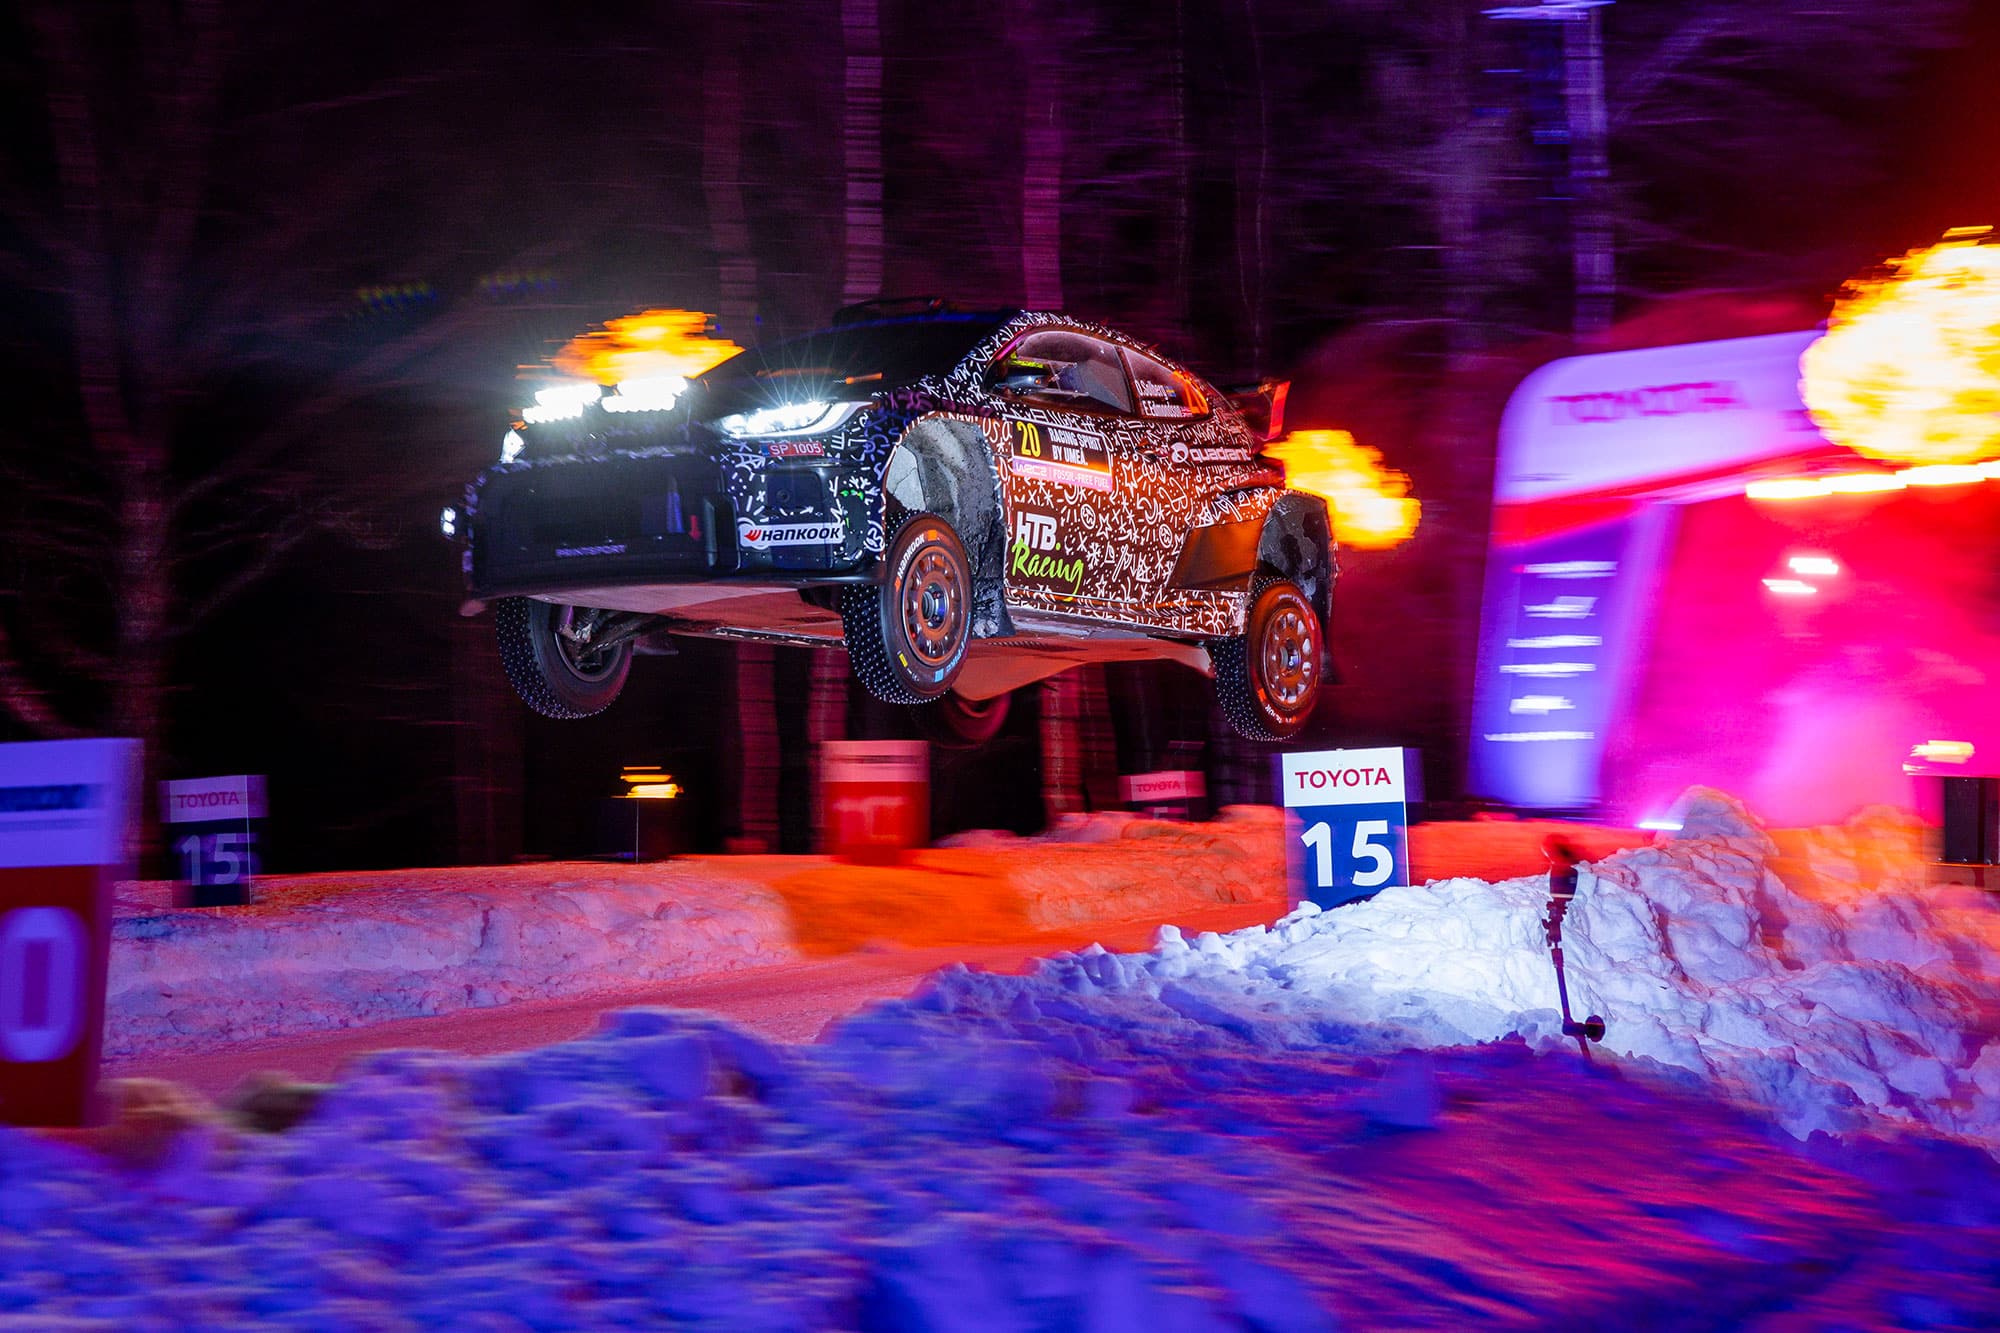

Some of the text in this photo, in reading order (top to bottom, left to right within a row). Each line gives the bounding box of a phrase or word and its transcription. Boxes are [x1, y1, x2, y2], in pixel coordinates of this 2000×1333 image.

[770, 443, 821, 455] SP 1005
[1016, 420, 1041, 458] 20
[1048, 427, 1103, 451] RACING SPIRIT
[1052, 445, 1063, 461] BY
[1190, 447, 1251, 462] quadrant
[1095, 476, 1109, 488] FUEL
[1011, 537, 1084, 600] Racing
[1136, 780, 1181, 792] TOYOTA
[1294, 767, 1391, 789] TOYOTA
[176, 791, 239, 809] TOYOTA
[179, 832, 241, 887] 15
[1300, 819, 1394, 888] 15
